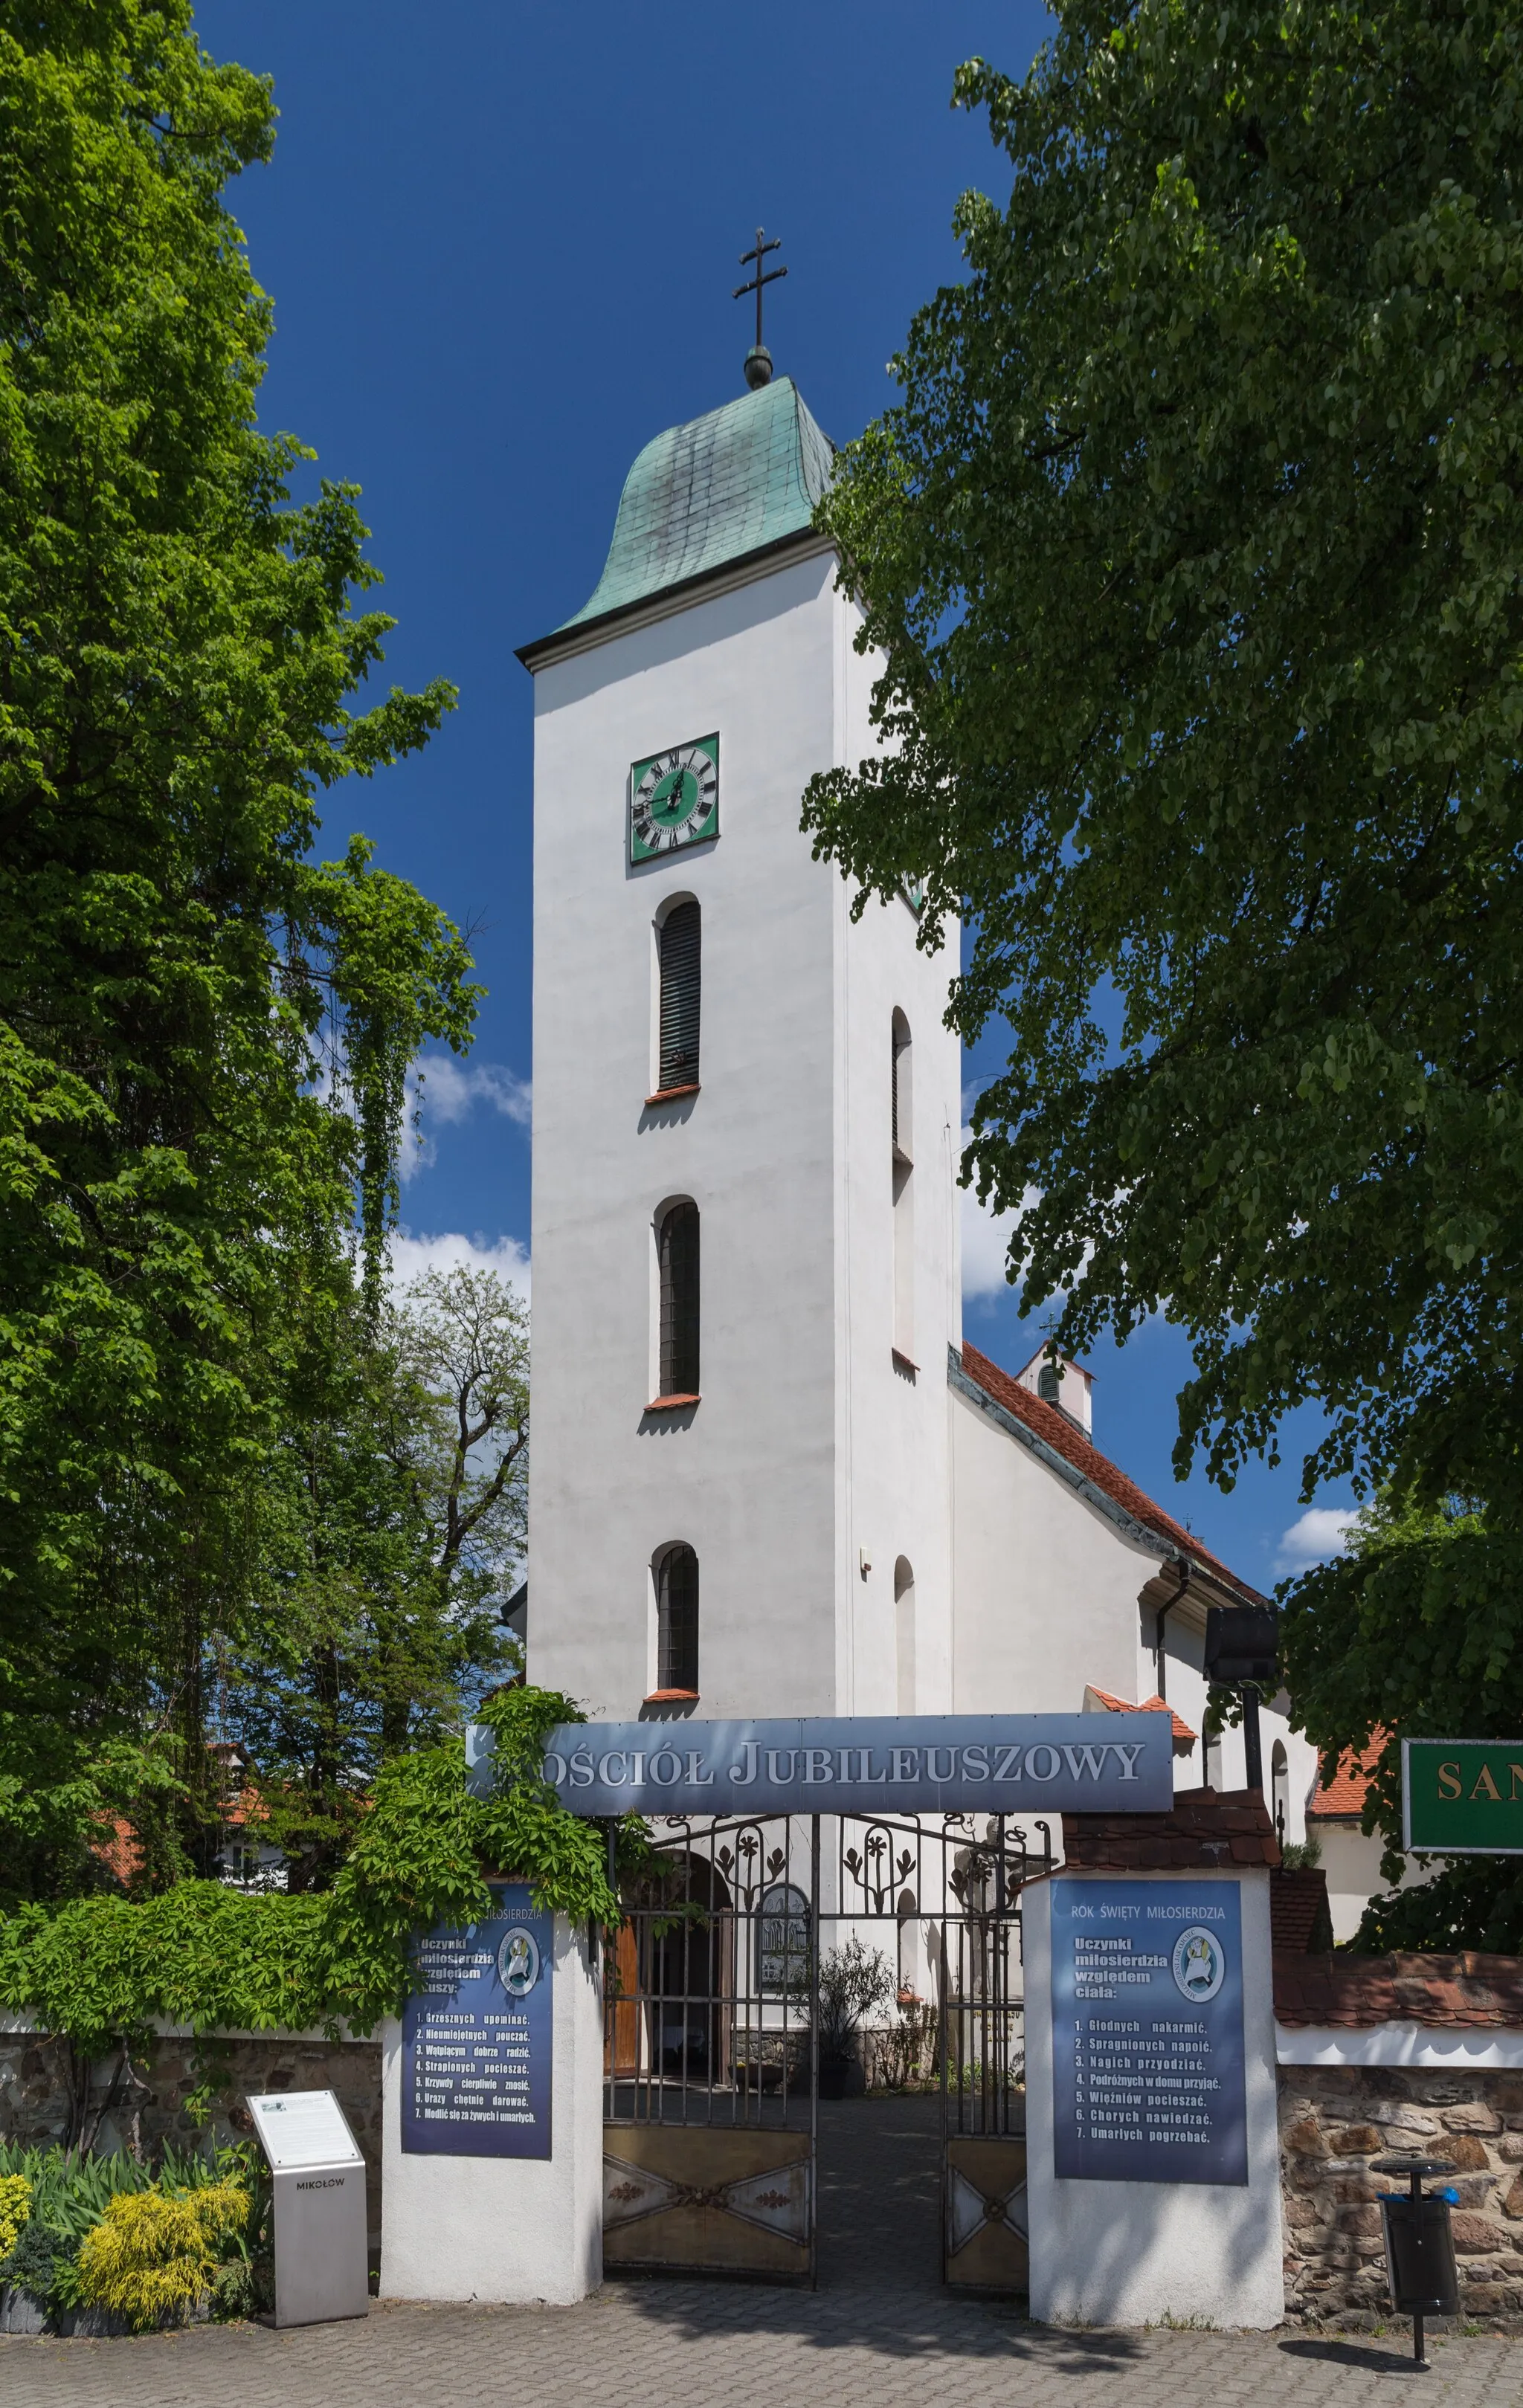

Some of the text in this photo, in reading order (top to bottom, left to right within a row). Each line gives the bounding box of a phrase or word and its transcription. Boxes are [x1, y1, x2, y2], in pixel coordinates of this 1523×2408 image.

[541, 1741, 714, 1786] OŚCIÓŁ
[1072, 1902, 1226, 1921] ROK ŚWIĘTY MIŁOSIERDZIA
[1075, 1937, 1132, 1951] Uczynki
[1075, 1955, 1168, 1967] miłosierdzia
[1075, 1971, 1150, 1983] względem
[1075, 1986, 1117, 1998] ciała:
[417, 2012, 530, 2025] 1. Grzesznych upominać.
[1075, 2019, 1208, 2034] 1. Głodnych nakarmić.
[416, 2029, 530, 2041] 2. Nieumiejętnych pouczać.
[416, 2044, 530, 2058] 3. Wątpiącym dobrze radzić.
[1075, 2038, 1212, 2053] 2. Spragnionych napoić.
[416, 2061, 529, 2074] 4. Strapionych pocieszać.
[1075, 2056, 1206, 2071] 3. Nagich przyodziać.
[416, 2076, 529, 2090] 5. Krzywdy cierpliwie znosić.
[1076, 2073, 1221, 2091] 4. Podróżnych w domu przyjąć.
[416, 2093, 528, 2106] 6. Urazy chętnie darować.
[1076, 2091, 1207, 2107] 5. Więźniów pocieszać.
[416, 2108, 421, 2118] 7.
[425, 2108, 448, 2119] Modlić
[449, 2109, 460, 2121] się
[461, 2111, 469, 2120] za
[470, 2110, 495, 2122] żywych
[500, 2112, 535, 2123] umarłych.
[1076, 2109, 1213, 2125] 6. Chorych nawiedzać.
[1077, 2127, 1210, 2143] 7. Umarłych pogrzebać.
[297, 2178, 345, 2191] MIKOŁÓW
